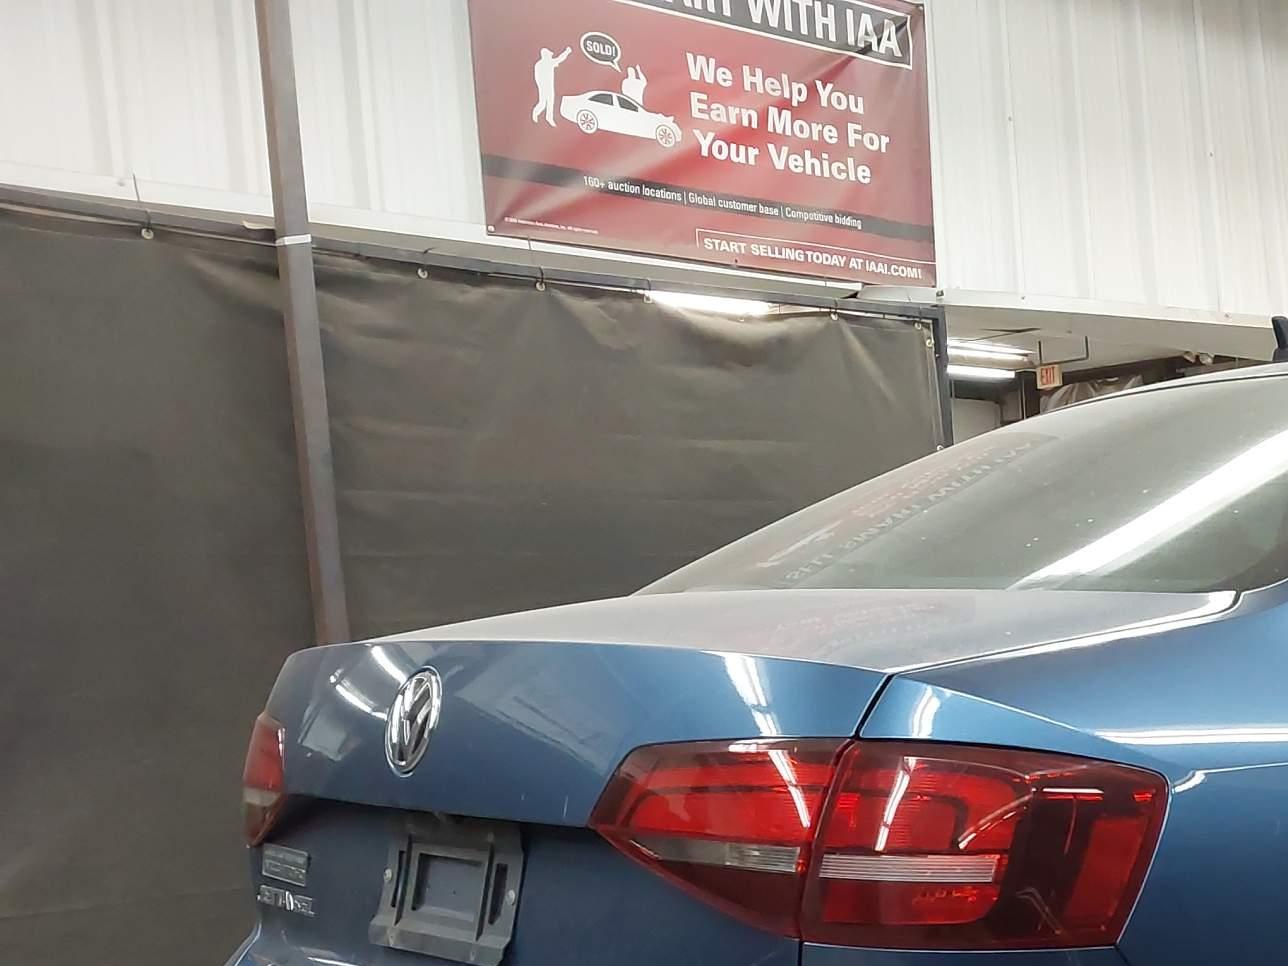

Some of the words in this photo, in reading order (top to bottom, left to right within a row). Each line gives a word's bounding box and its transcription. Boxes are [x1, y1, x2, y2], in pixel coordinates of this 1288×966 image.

[586, 40, 616, 57] SOLD!
[748, 0, 837, 42] WITH
[846, 9, 903, 57] IAA
[686, 52, 733, 87] We
[742, 65, 808, 106] Help
[815, 80, 865, 115] You
[689, 91, 758, 129] Earn
[767, 106, 839, 145] More
[847, 123, 890, 153] For
[693, 129, 760, 166] Your
[767, 143, 872, 184] Vehicle
[583, 175, 605, 189] 160+
[607, 179, 641, 195] auction
[642, 185, 682, 202] locations
[688, 192, 716, 207] Global
[718, 199, 757, 214] customer
[758, 201, 779, 216] base
[785, 207, 833, 224] Competitive
[834, 214, 862, 230] bidding
[704, 238, 748, 254] START
[750, 244, 805, 262] SELLING
[806, 250, 847, 267] TODAY
[849, 257, 864, 270] AT
[865, 260, 922, 279] IAAI.COM!
[1040, 366, 1056, 385] EXIT
